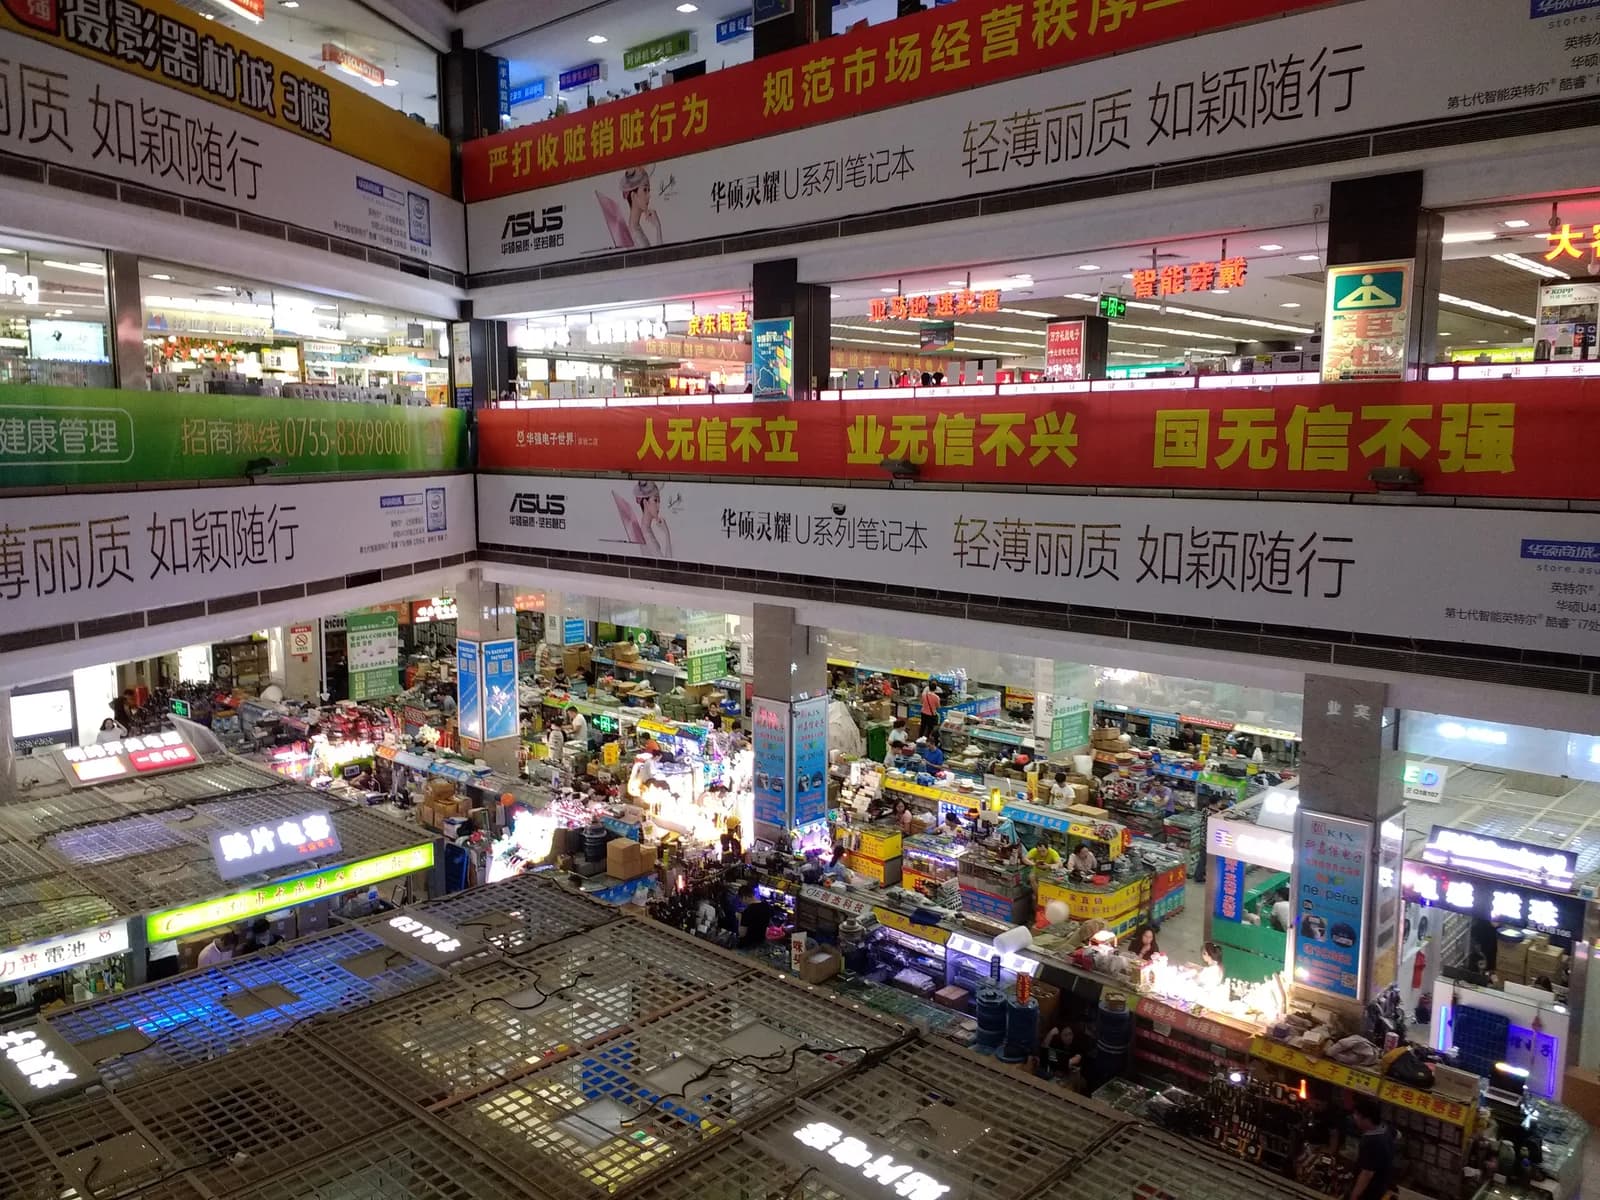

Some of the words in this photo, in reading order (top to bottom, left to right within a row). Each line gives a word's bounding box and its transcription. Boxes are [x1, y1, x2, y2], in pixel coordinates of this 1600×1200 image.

[488, 93, 710, 184] 严打收赃销赃行为
[762, 0, 1192, 118] 规范市场经营秩序
[961, 88, 1132, 178] 轻薄丽质
[1146, 44, 1366, 147] 如颖随行
[91, 83, 263, 200] 如颖随行
[711, 144, 915, 215] 华硕灵耀U系列笔记本
[501, 205, 564, 240] ASUS
[1131, 256, 1249, 299] 智能穿戴
[687, 311, 748, 337] 京东淘宝
[526, 431, 574, 446] 华强电子世界
[637, 416, 799, 462] 人无信不立
[847, 410, 1078, 468] 业无信不兴
[1153, 403, 1516, 474] 国无信不强
[509, 492, 565, 516] ASUS
[147, 503, 300, 582] 如颖随行
[720, 507, 928, 556] 华硕灵耀U系列笔记本
[953, 514, 1121, 581] 轻薄丽质
[1135, 524, 1355, 599] 如颖随行
[1383, 1085, 1465, 1129] 光电传感器
